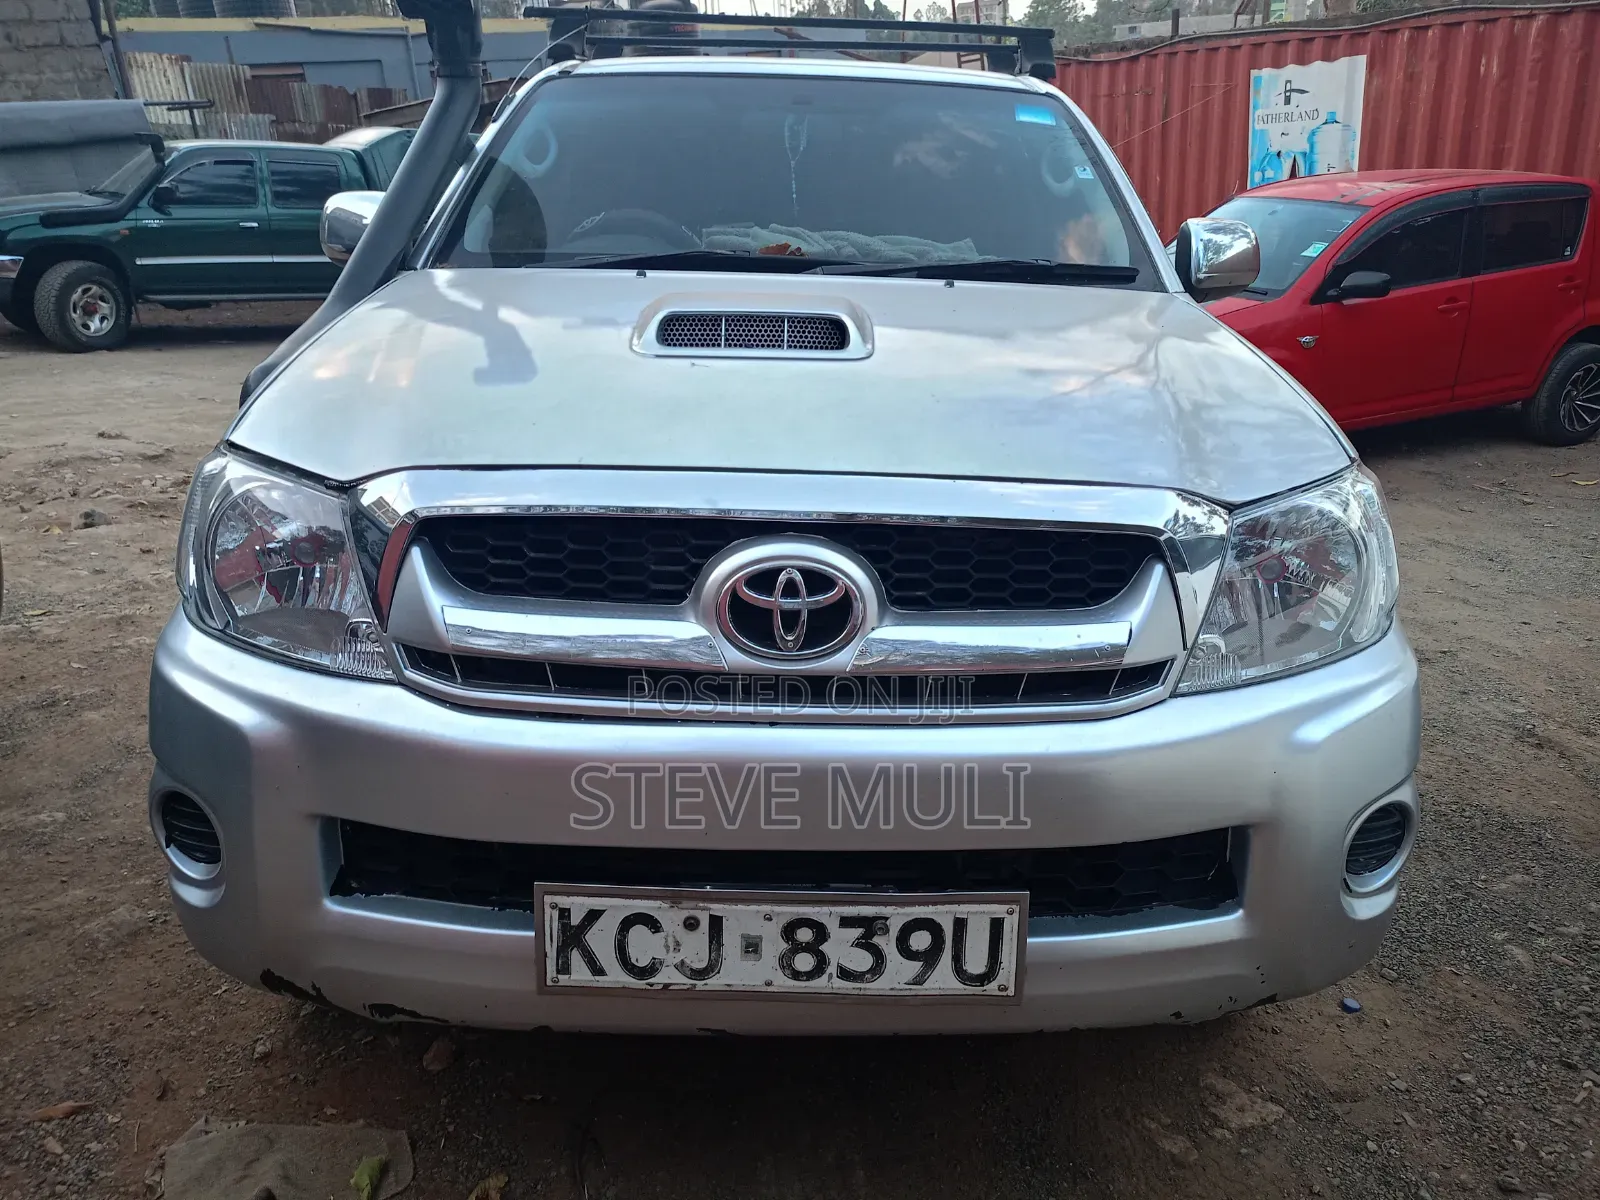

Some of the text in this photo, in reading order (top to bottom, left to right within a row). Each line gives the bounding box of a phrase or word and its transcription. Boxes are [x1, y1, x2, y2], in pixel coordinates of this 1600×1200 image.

[1256, 108, 1320, 125] FATHERLAND
[556, 907, 1006, 987] KCJ 839U
